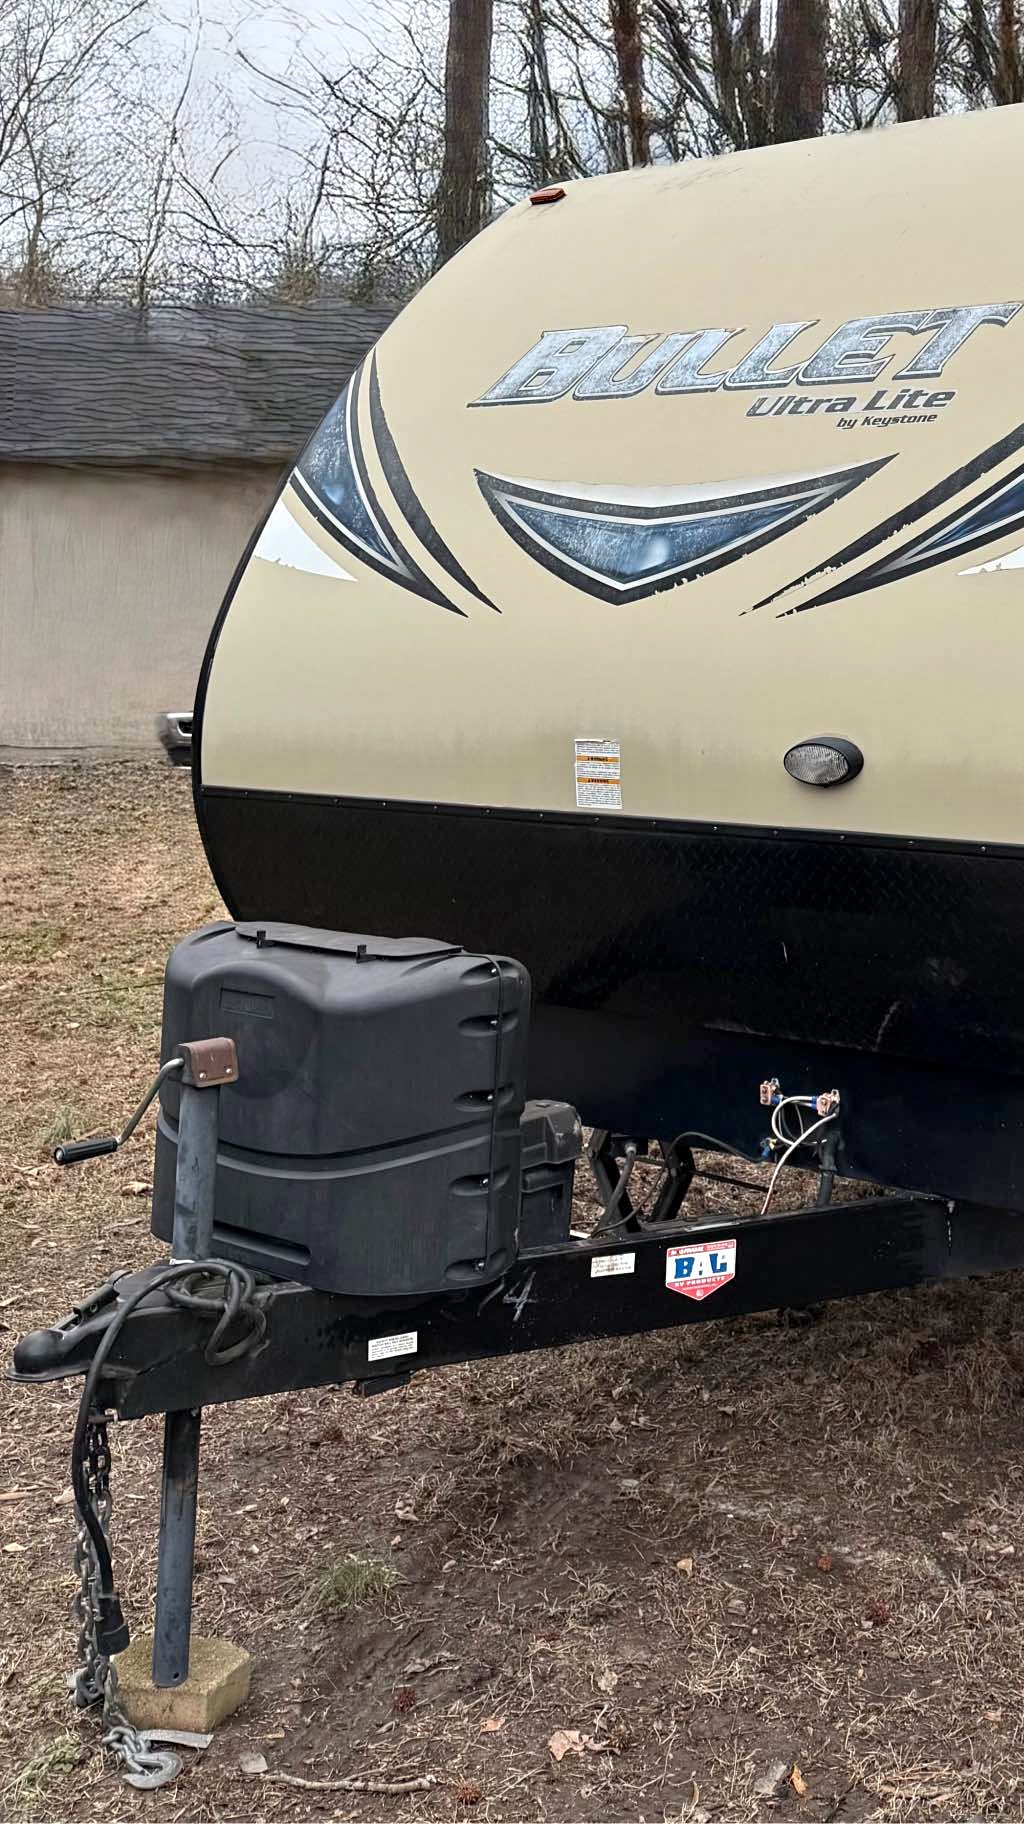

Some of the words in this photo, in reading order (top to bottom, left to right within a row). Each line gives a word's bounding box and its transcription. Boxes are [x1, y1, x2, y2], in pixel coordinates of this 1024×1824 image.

[746, 395, 858, 417] Ultra
[862, 388, 956, 411] Lite
[836, 417, 858, 430] by
[861, 413, 938, 428] Keystone
[674, 1252, 728, 1280] BAL
